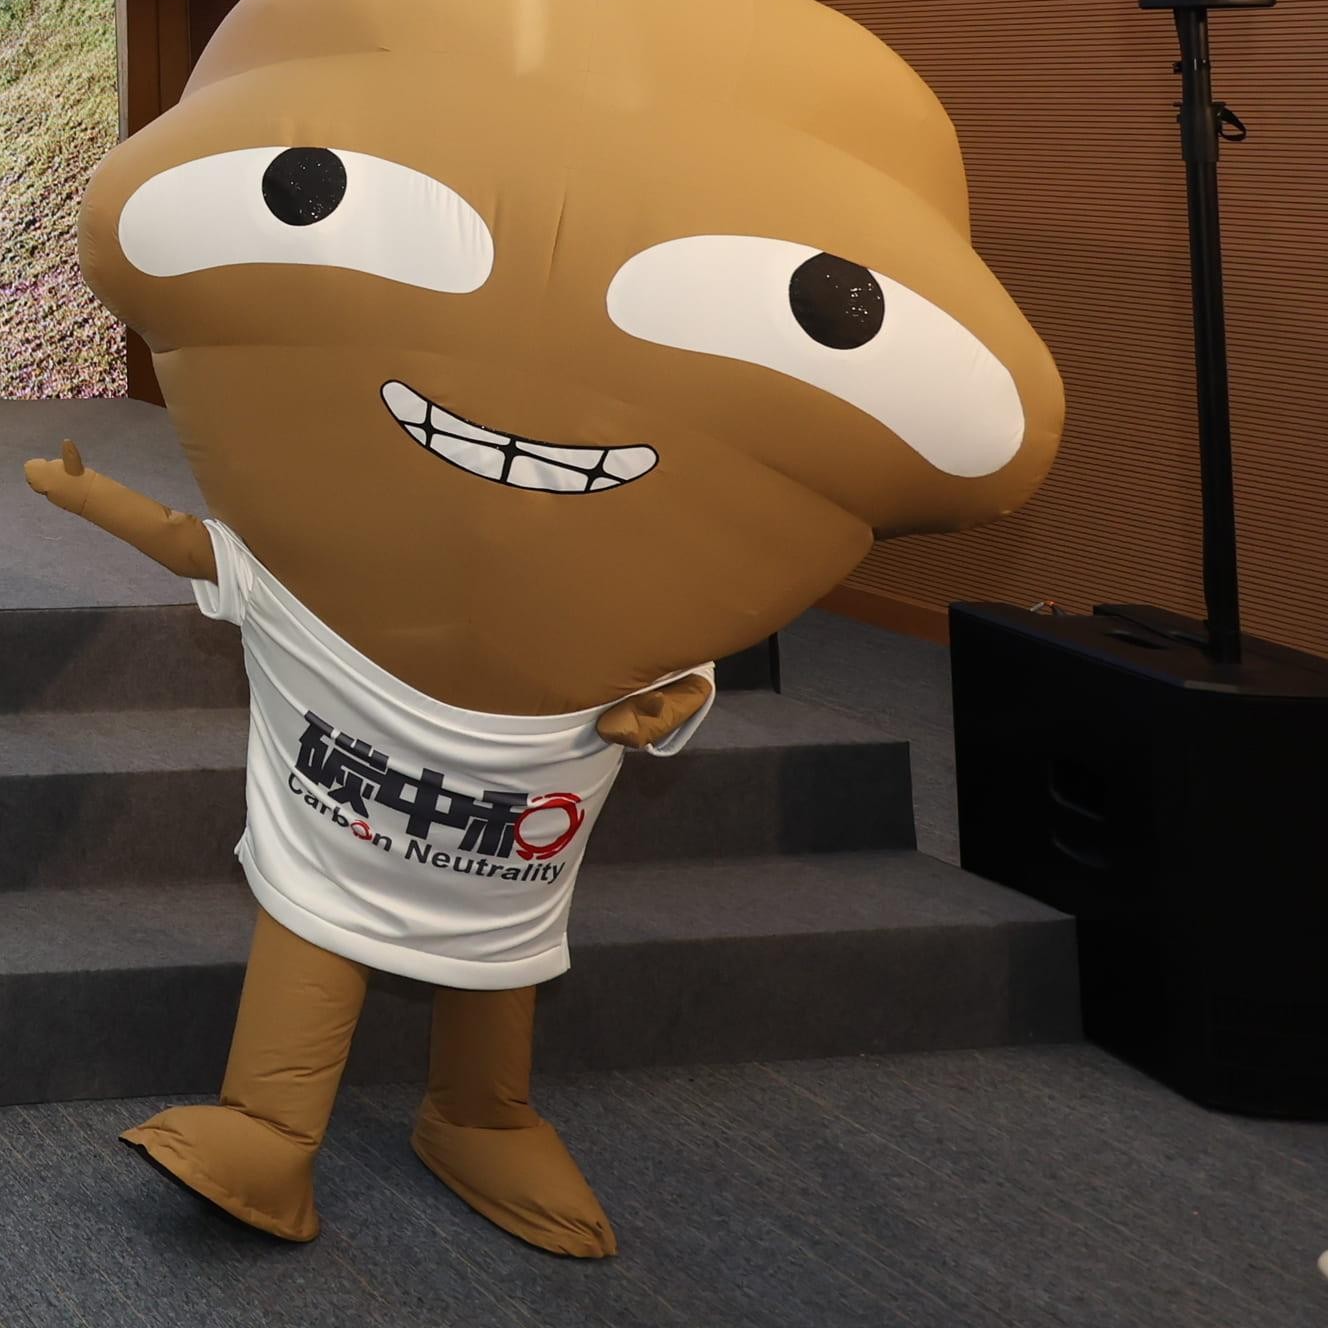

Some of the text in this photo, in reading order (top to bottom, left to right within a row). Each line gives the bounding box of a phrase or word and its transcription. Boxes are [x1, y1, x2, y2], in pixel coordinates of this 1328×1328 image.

[288, 772, 565, 885] Carbon Neutrality
[294, 710, 585, 860] 碳中和
